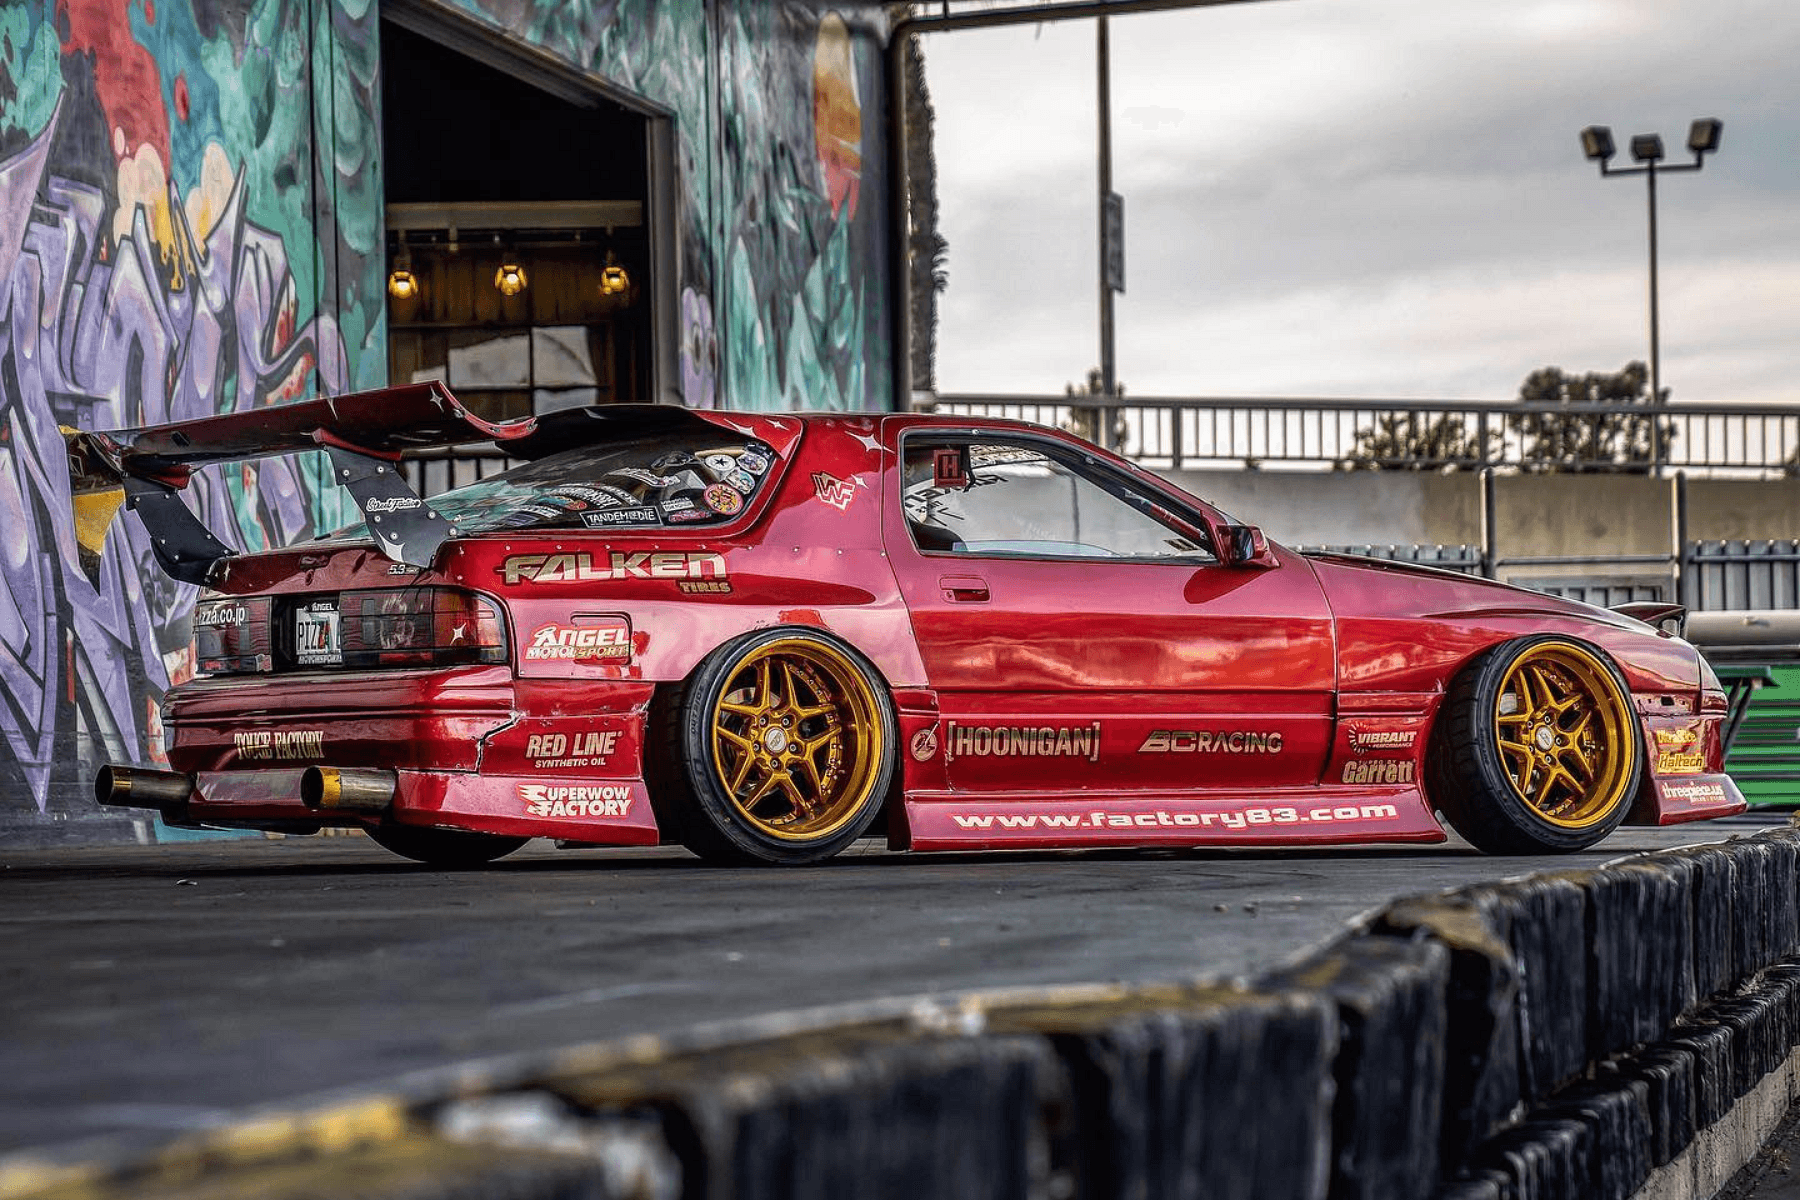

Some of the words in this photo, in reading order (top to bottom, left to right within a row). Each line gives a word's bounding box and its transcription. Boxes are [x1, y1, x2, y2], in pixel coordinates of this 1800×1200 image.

[501, 553, 727, 583] FALKEN
[680, 581, 731, 593] TIRES
[534, 627, 631, 647] ANGEL
[274, 730, 325, 759] FACTORY
[526, 734, 567, 758] RED
[572, 731, 617, 756] LINE
[1358, 731, 1417, 744] VIBRANT
[534, 758, 588, 768] SYNTHETIC
[591, 757, 606, 766] OIL
[1659, 753, 1704, 768] Haltech
[1342, 760, 1414, 783] Garrett
[518, 785, 631, 801] SUPERWOW
[526, 800, 632, 816] FACTORY
[953, 803, 1398, 829] www.factory83.com
